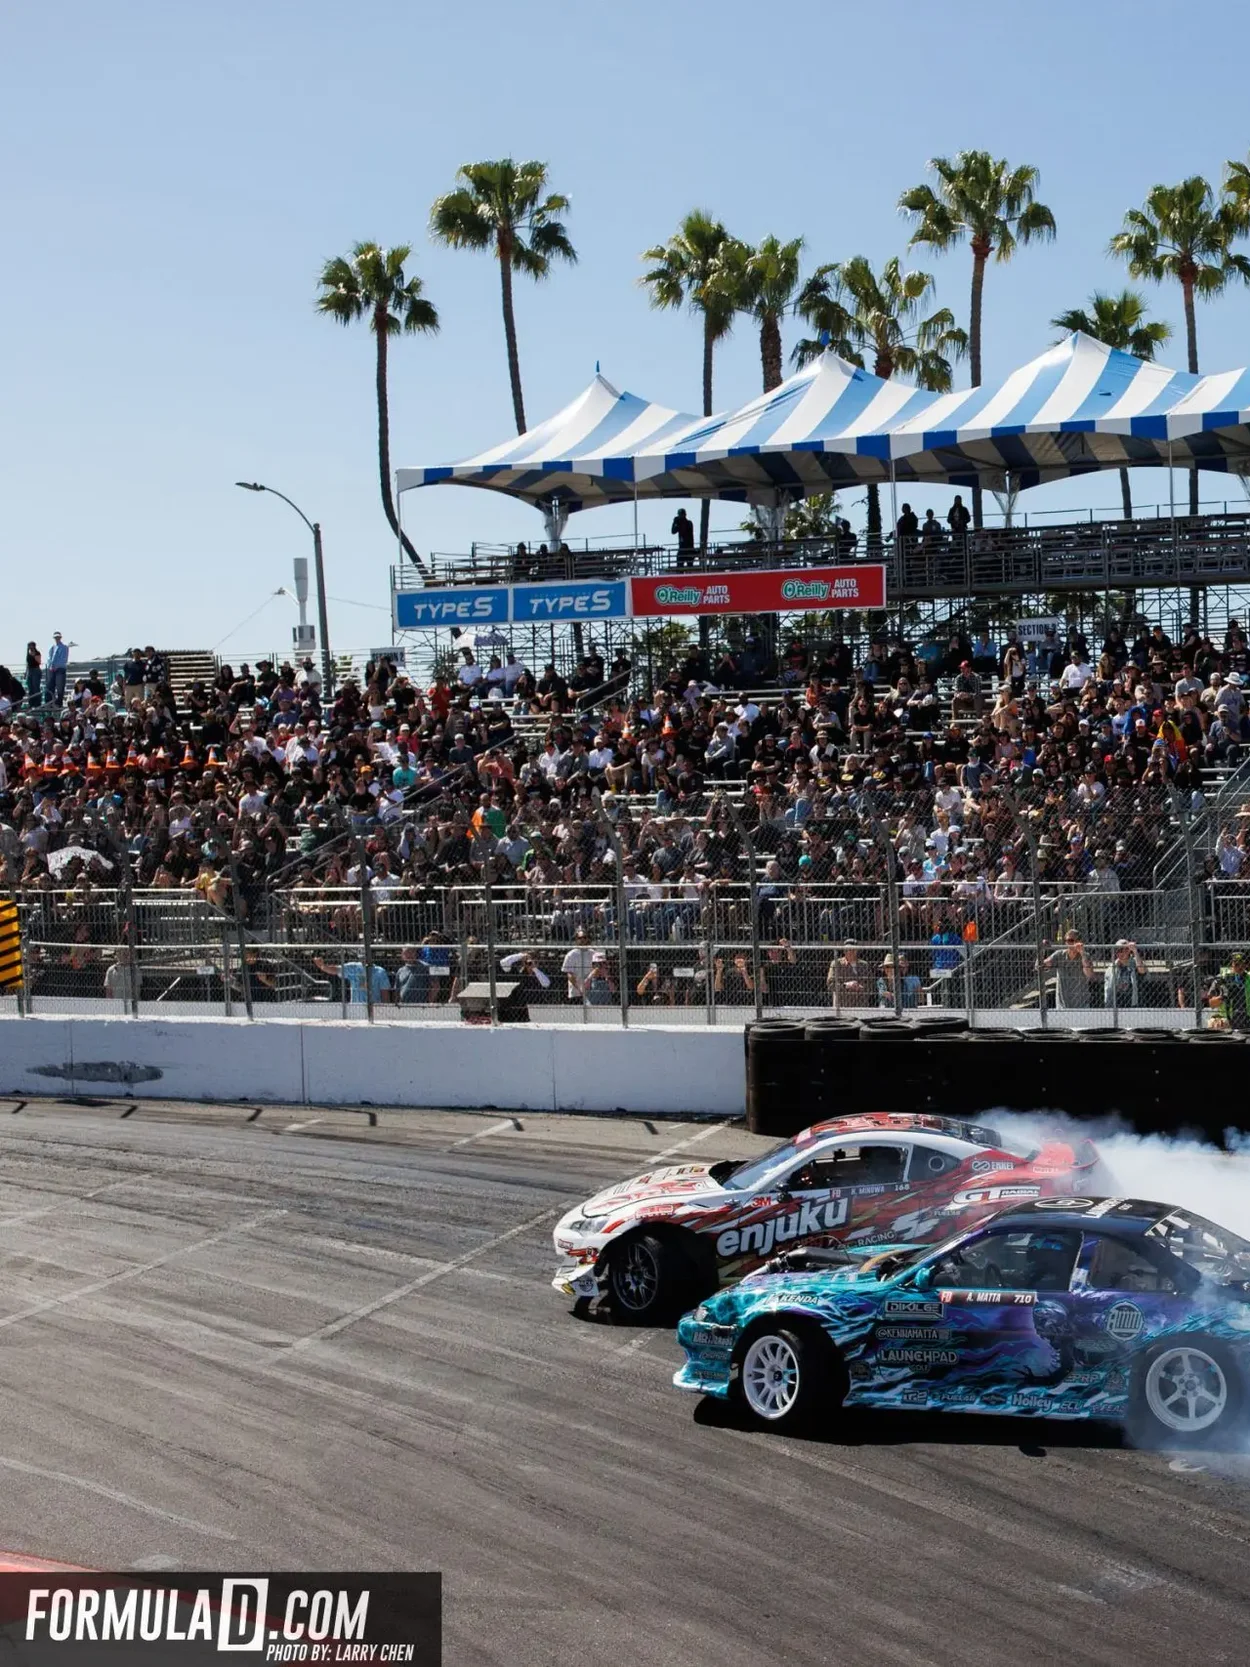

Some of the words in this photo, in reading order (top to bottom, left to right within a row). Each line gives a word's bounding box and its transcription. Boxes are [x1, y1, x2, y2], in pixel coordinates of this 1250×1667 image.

[834, 579, 856, 588] AUTO
[706, 585, 728, 594] AUTO
[831, 588, 859, 598] PARTS
[703, 594, 730, 604] PARTS
[752, 1196, 772, 1207] 3M
[716, 1196, 848, 1257] enjuku
[857, 1231, 895, 1247] RACING
[780, 1293, 820, 1305] KENDA
[967, 1293, 974, 1302] A.
[977, 1292, 1001, 1303] MATTA
[1014, 1294, 1032, 1303] 710
[881, 1350, 958, 1363] LAUNCHPAD
[1011, 1393, 1052, 1410] Holley
